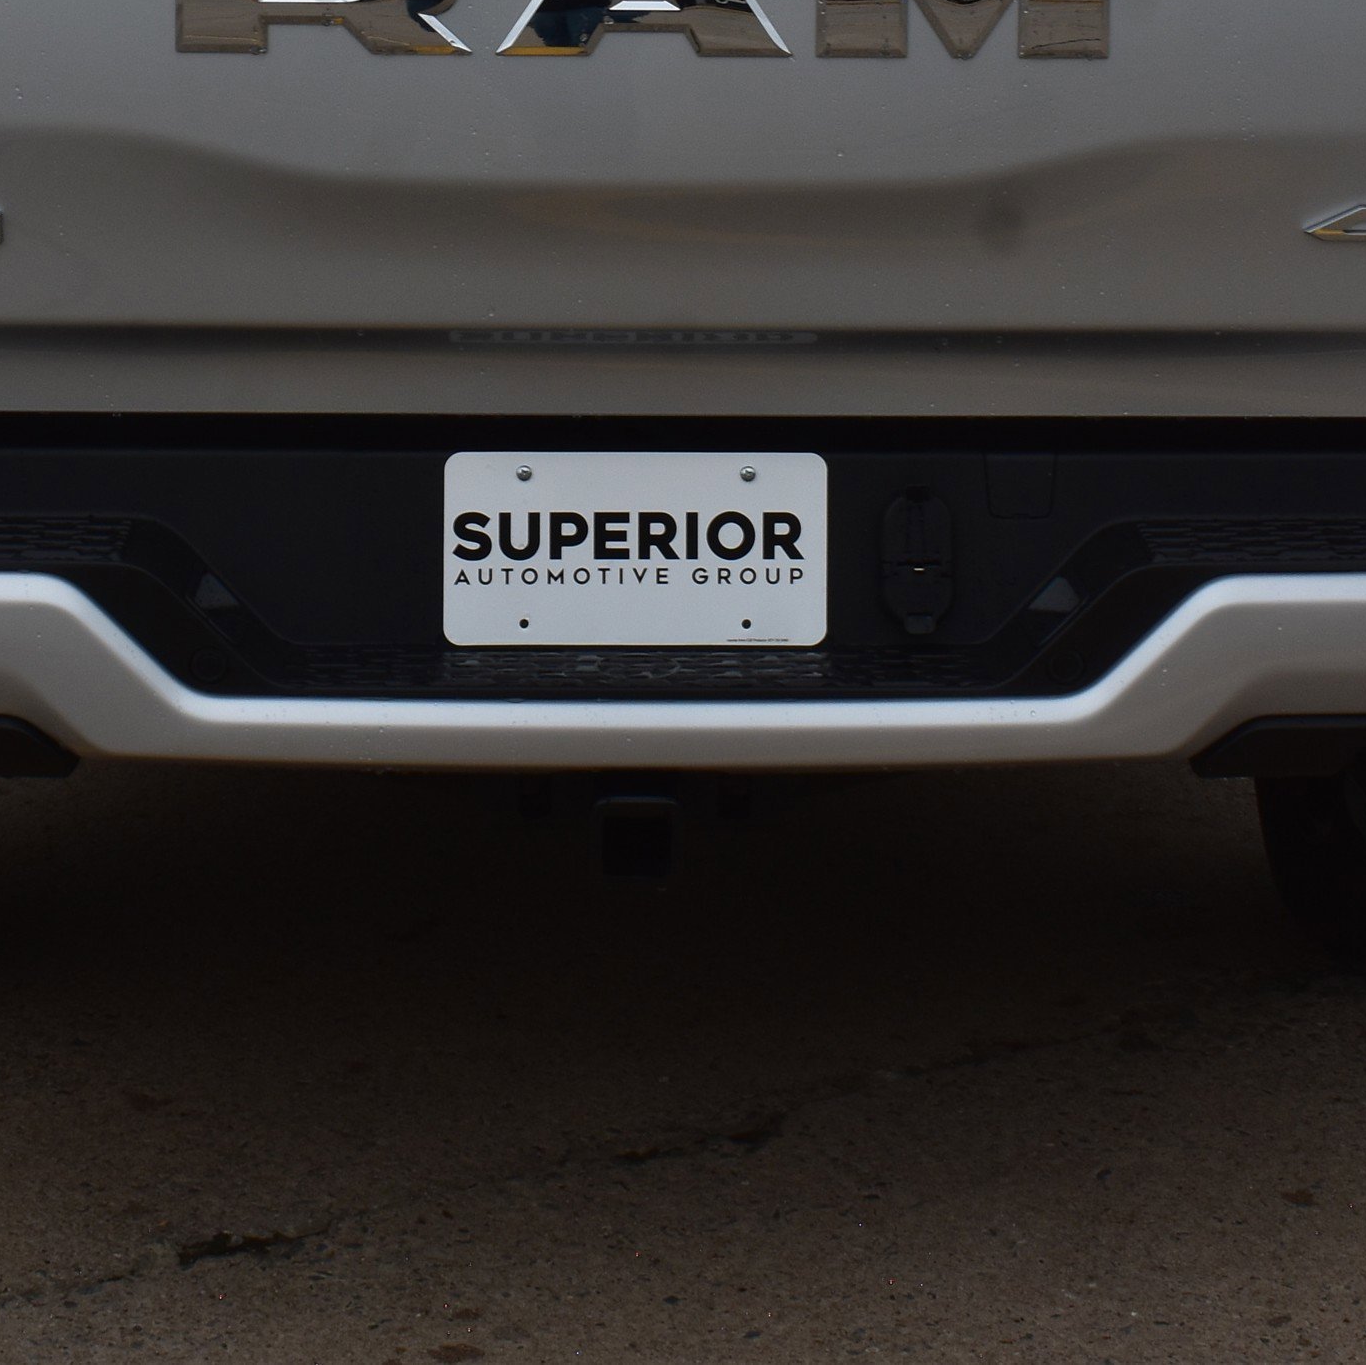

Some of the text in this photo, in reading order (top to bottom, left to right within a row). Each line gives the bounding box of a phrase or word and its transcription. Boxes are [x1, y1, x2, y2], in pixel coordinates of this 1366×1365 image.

[452, 511, 805, 562] SUPERIOR
[454, 567, 805, 586] AUTOMOTIVE GROUP
